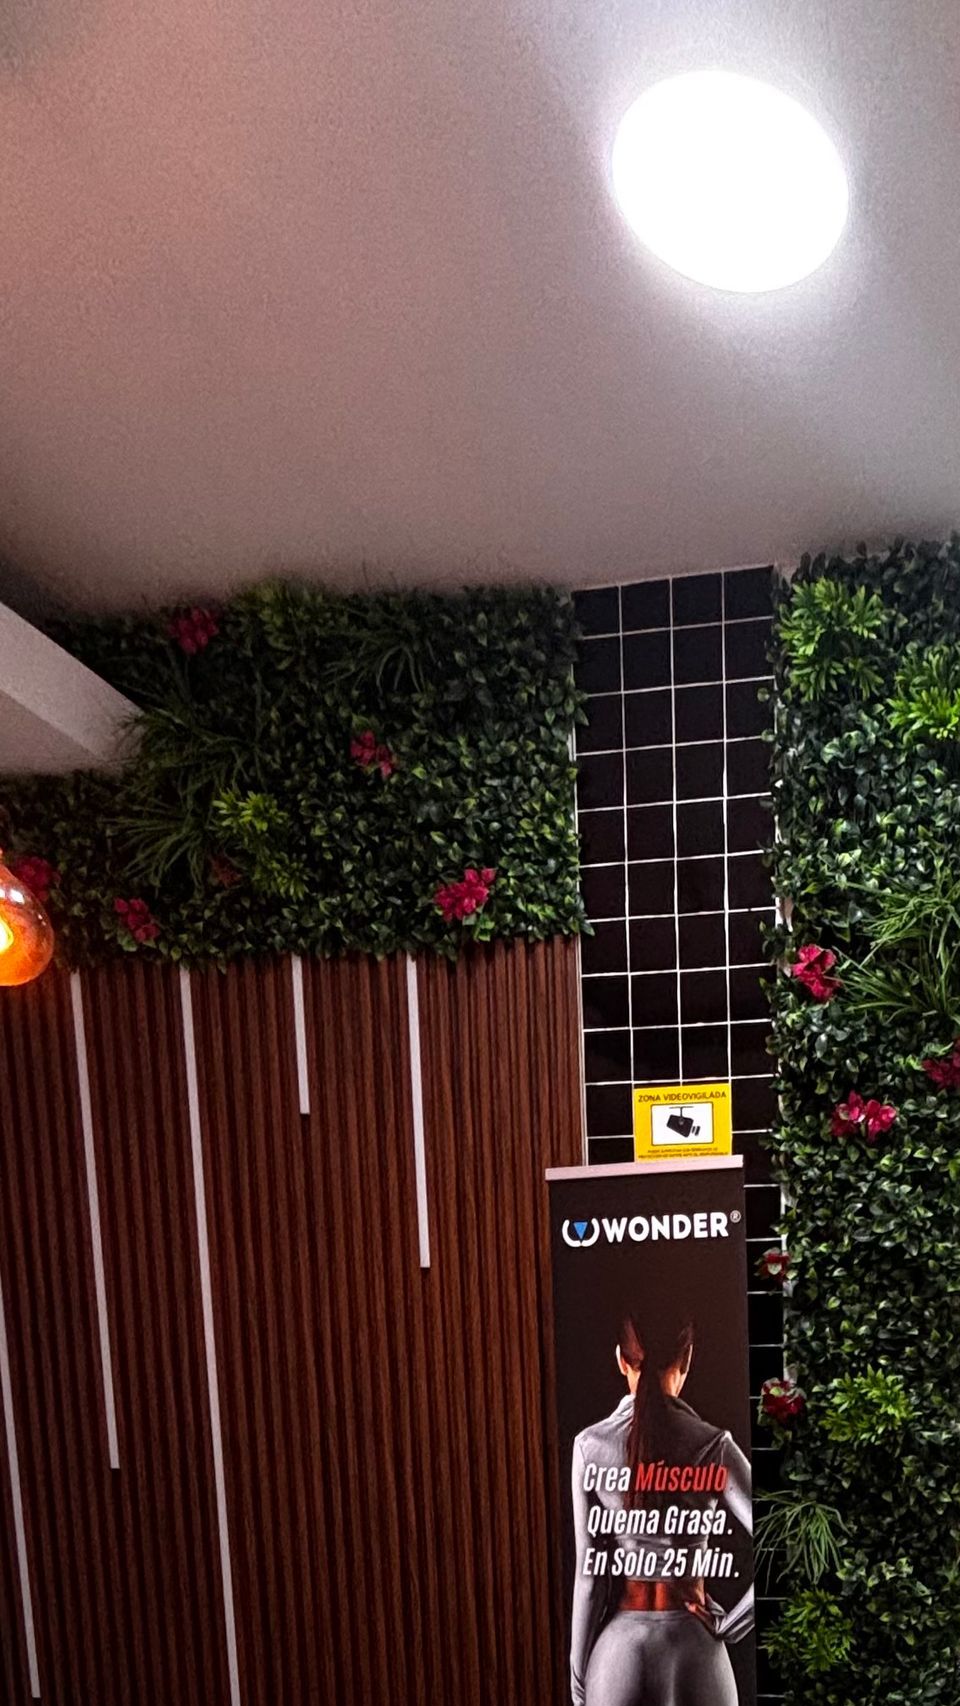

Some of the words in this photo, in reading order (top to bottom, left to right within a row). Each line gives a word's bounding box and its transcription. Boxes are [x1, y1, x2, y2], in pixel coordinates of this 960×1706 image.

[638, 1094, 661, 1103] ZONA
[663, 1091, 727, 1101] VIDEOVIGILADA
[583, 1463, 631, 1491] Crea
[635, 1460, 729, 1491] Músculo
[587, 1505, 660, 1537] Quema
[664, 1505, 733, 1535] Grasa.
[583, 1547, 607, 1576] En
[612, 1548, 657, 1577] Solo
[661, 1548, 688, 1577] 25
[691, 1547, 739, 1578] Min.
